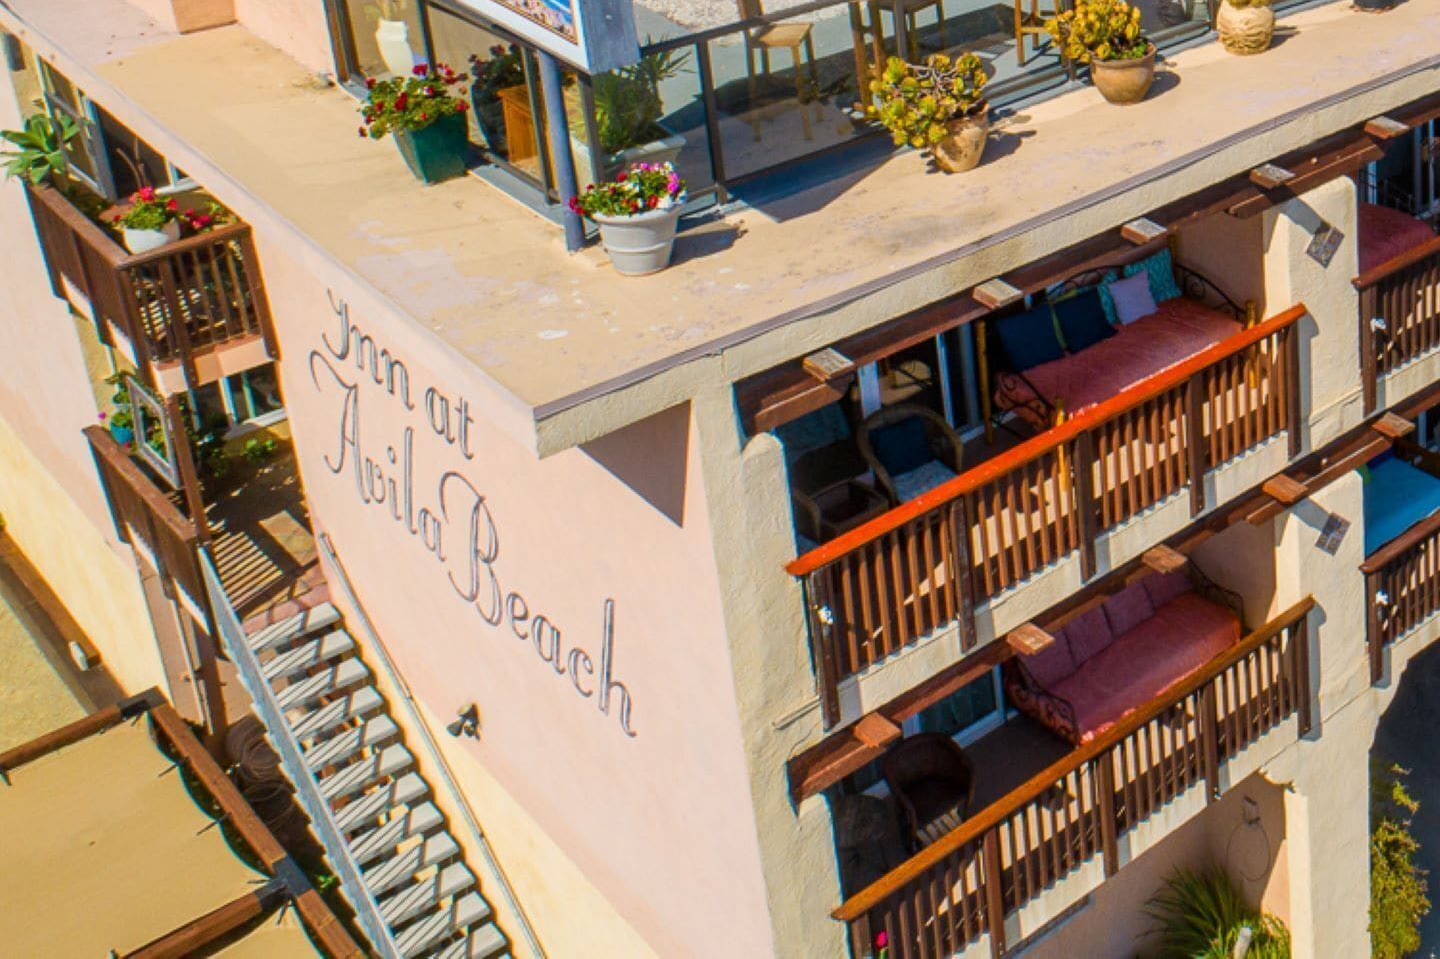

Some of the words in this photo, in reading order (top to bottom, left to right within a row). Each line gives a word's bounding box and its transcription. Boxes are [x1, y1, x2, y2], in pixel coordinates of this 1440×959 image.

[322, 288, 415, 411] Inn
[424, 385, 474, 459] at
[309, 348, 447, 562] Avila
[439, 470, 638, 738] Beach
